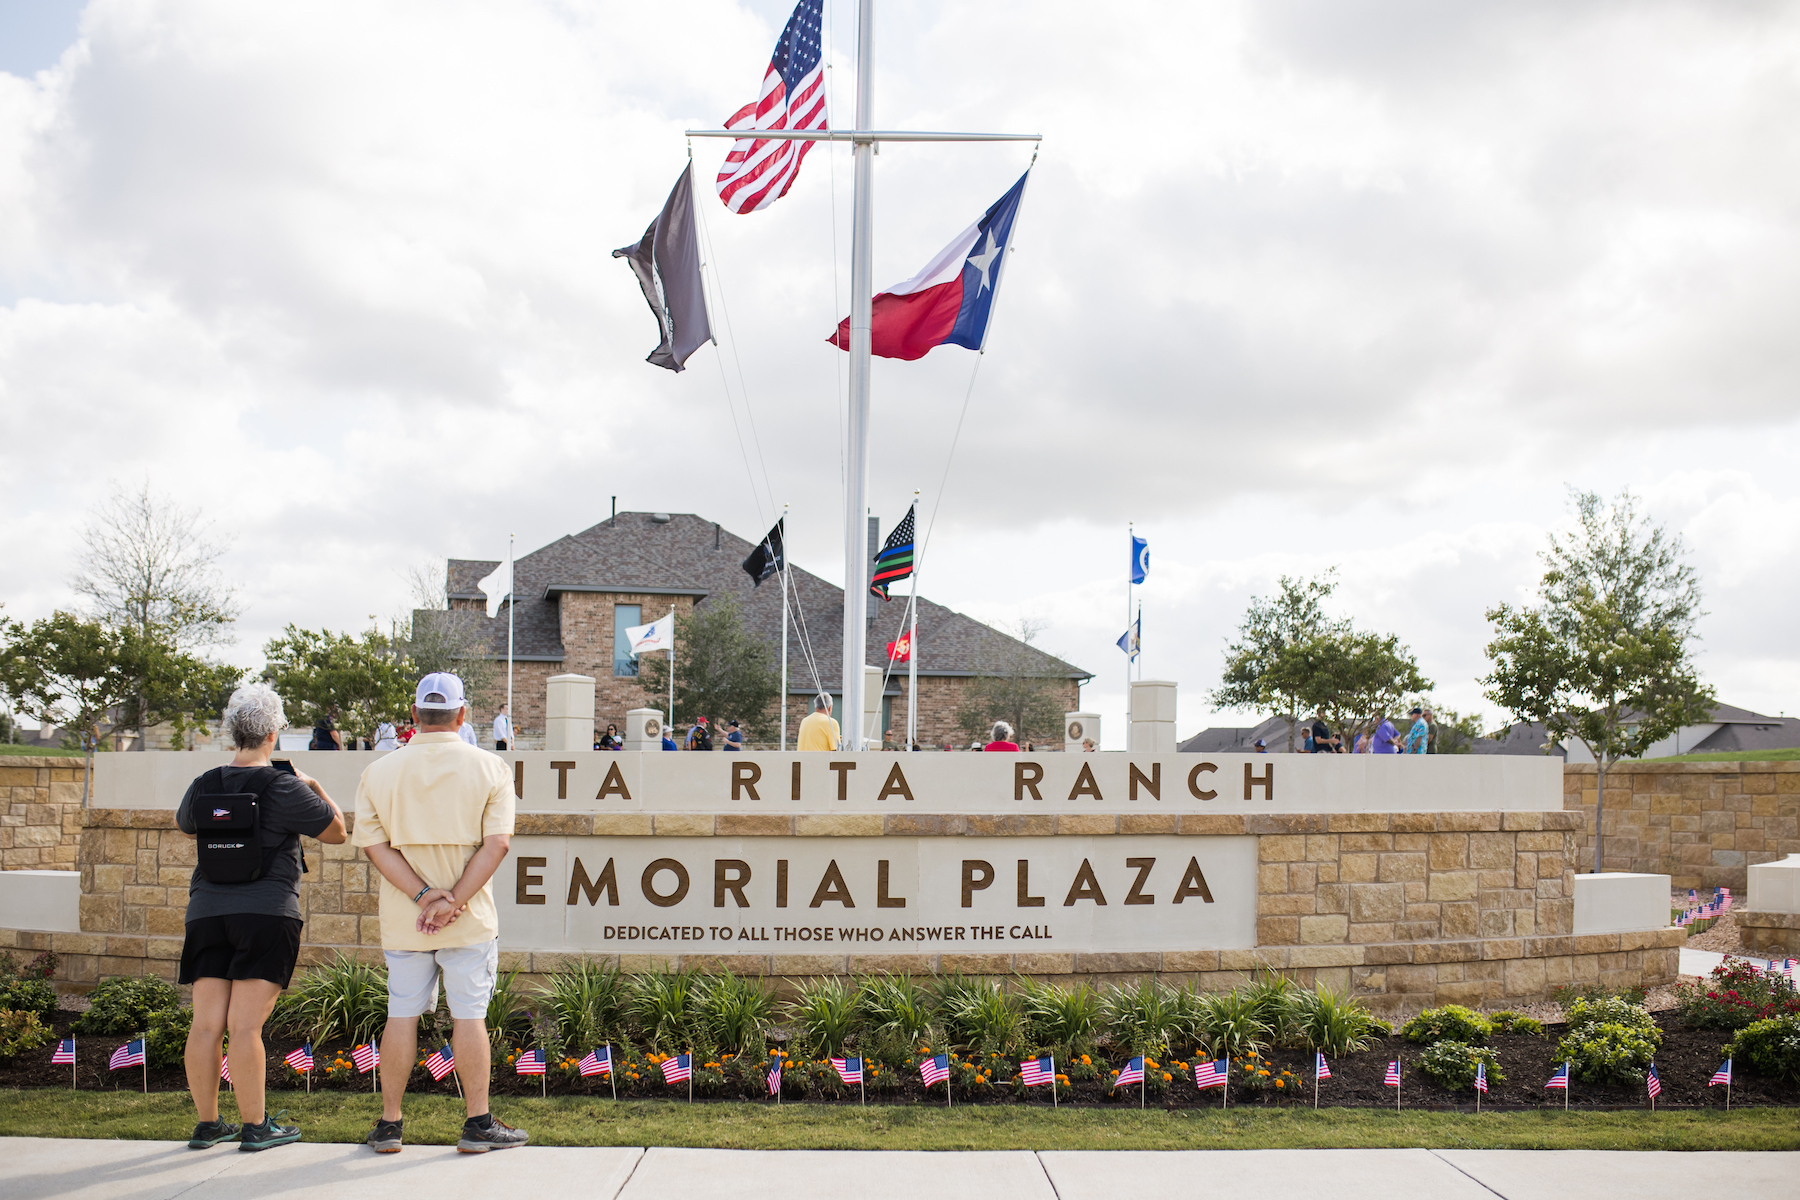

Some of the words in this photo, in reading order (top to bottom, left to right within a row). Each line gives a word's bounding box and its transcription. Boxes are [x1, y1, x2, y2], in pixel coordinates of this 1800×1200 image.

[731, 761, 915, 802] RITA
[1014, 761, 1274, 802] RANCH
[515, 856, 907, 909] EMORIAL
[960, 855, 1215, 908] PLAZA
[603, 925, 705, 942] DEDICATED
[708, 925, 734, 942] TO
[737, 925, 770, 942] ALL
[773, 926, 834, 942] THOSE
[837, 926, 885, 942] WHO
[887, 926, 966, 942] ANSWER
[969, 925, 1005, 941] THE
[1009, 924, 1053, 941] CALL
